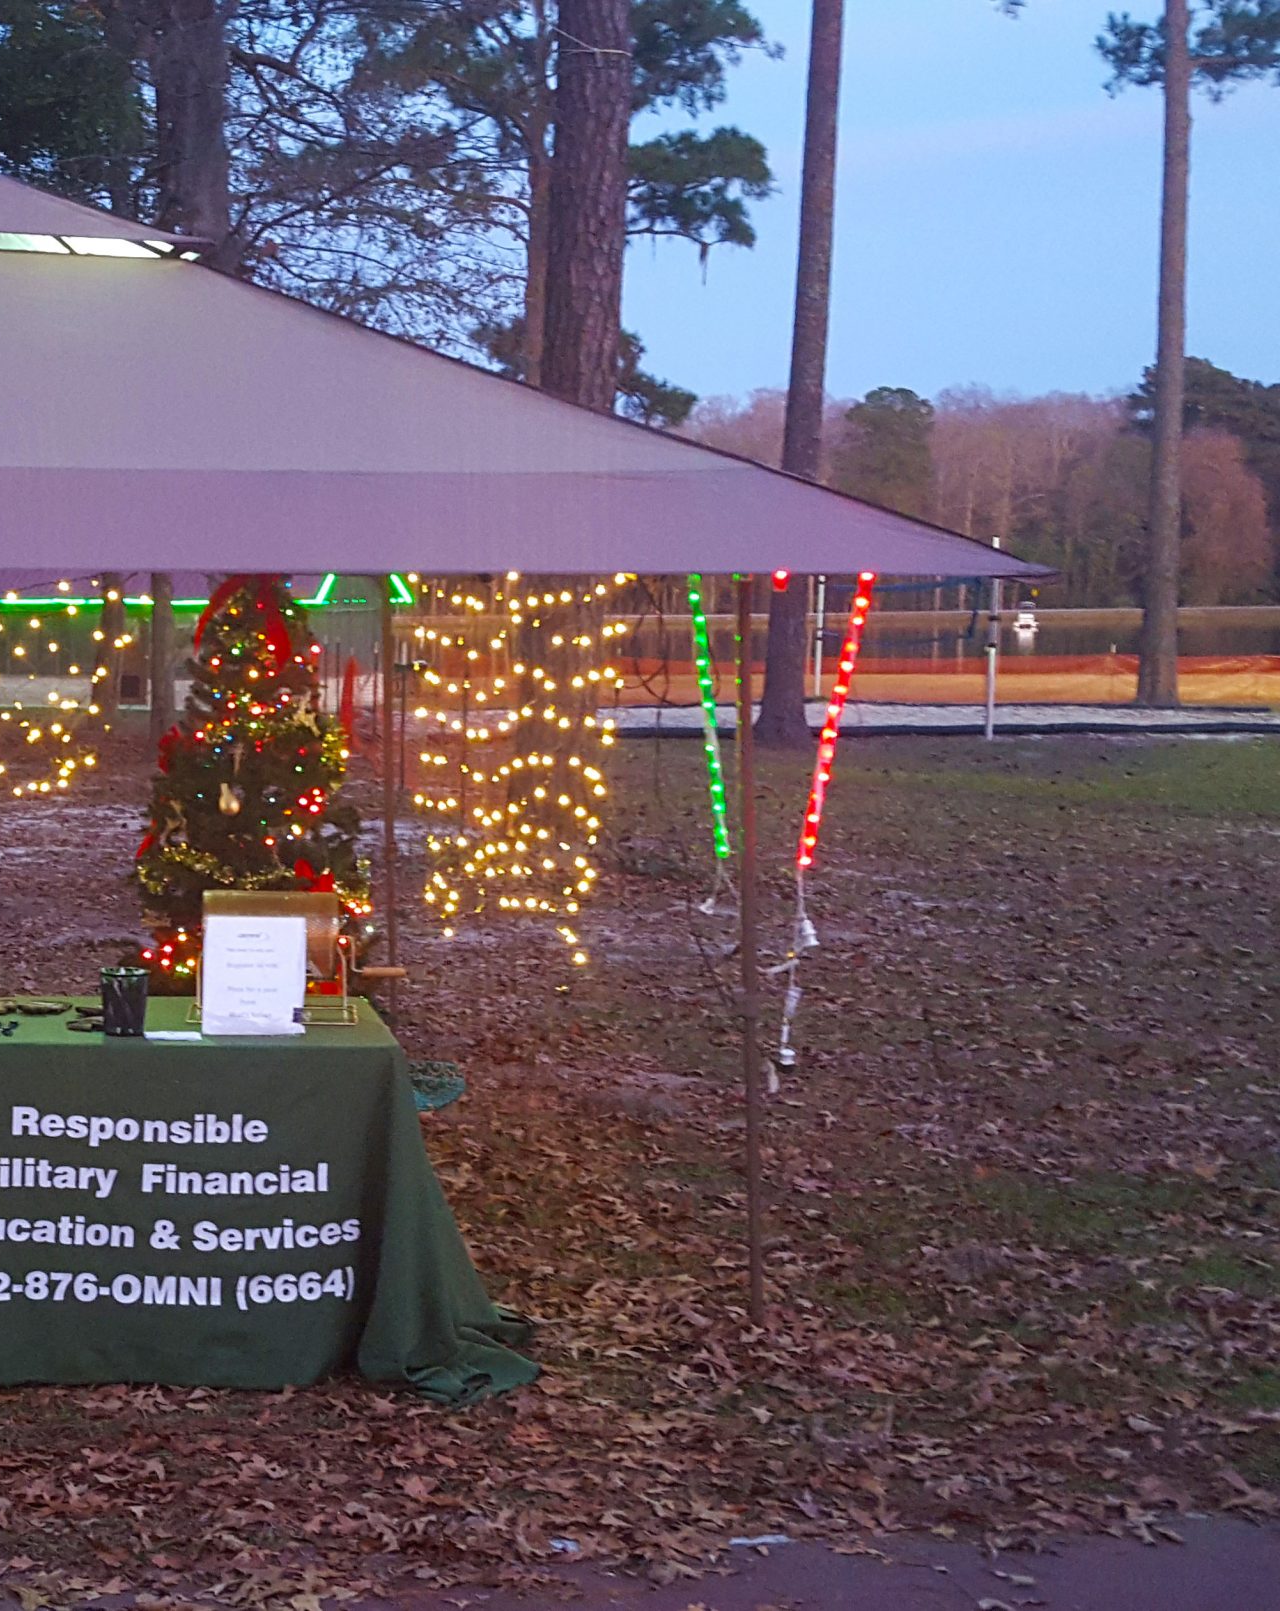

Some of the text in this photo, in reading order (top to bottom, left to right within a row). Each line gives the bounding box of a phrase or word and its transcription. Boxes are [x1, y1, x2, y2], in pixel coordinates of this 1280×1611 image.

[11, 1105, 269, 1145] Responsible
[141, 1162, 329, 1196] Financial
[149, 1219, 181, 1250] &
[191, 1218, 360, 1252] Services
[235, 1266, 354, 1311] (6664)
